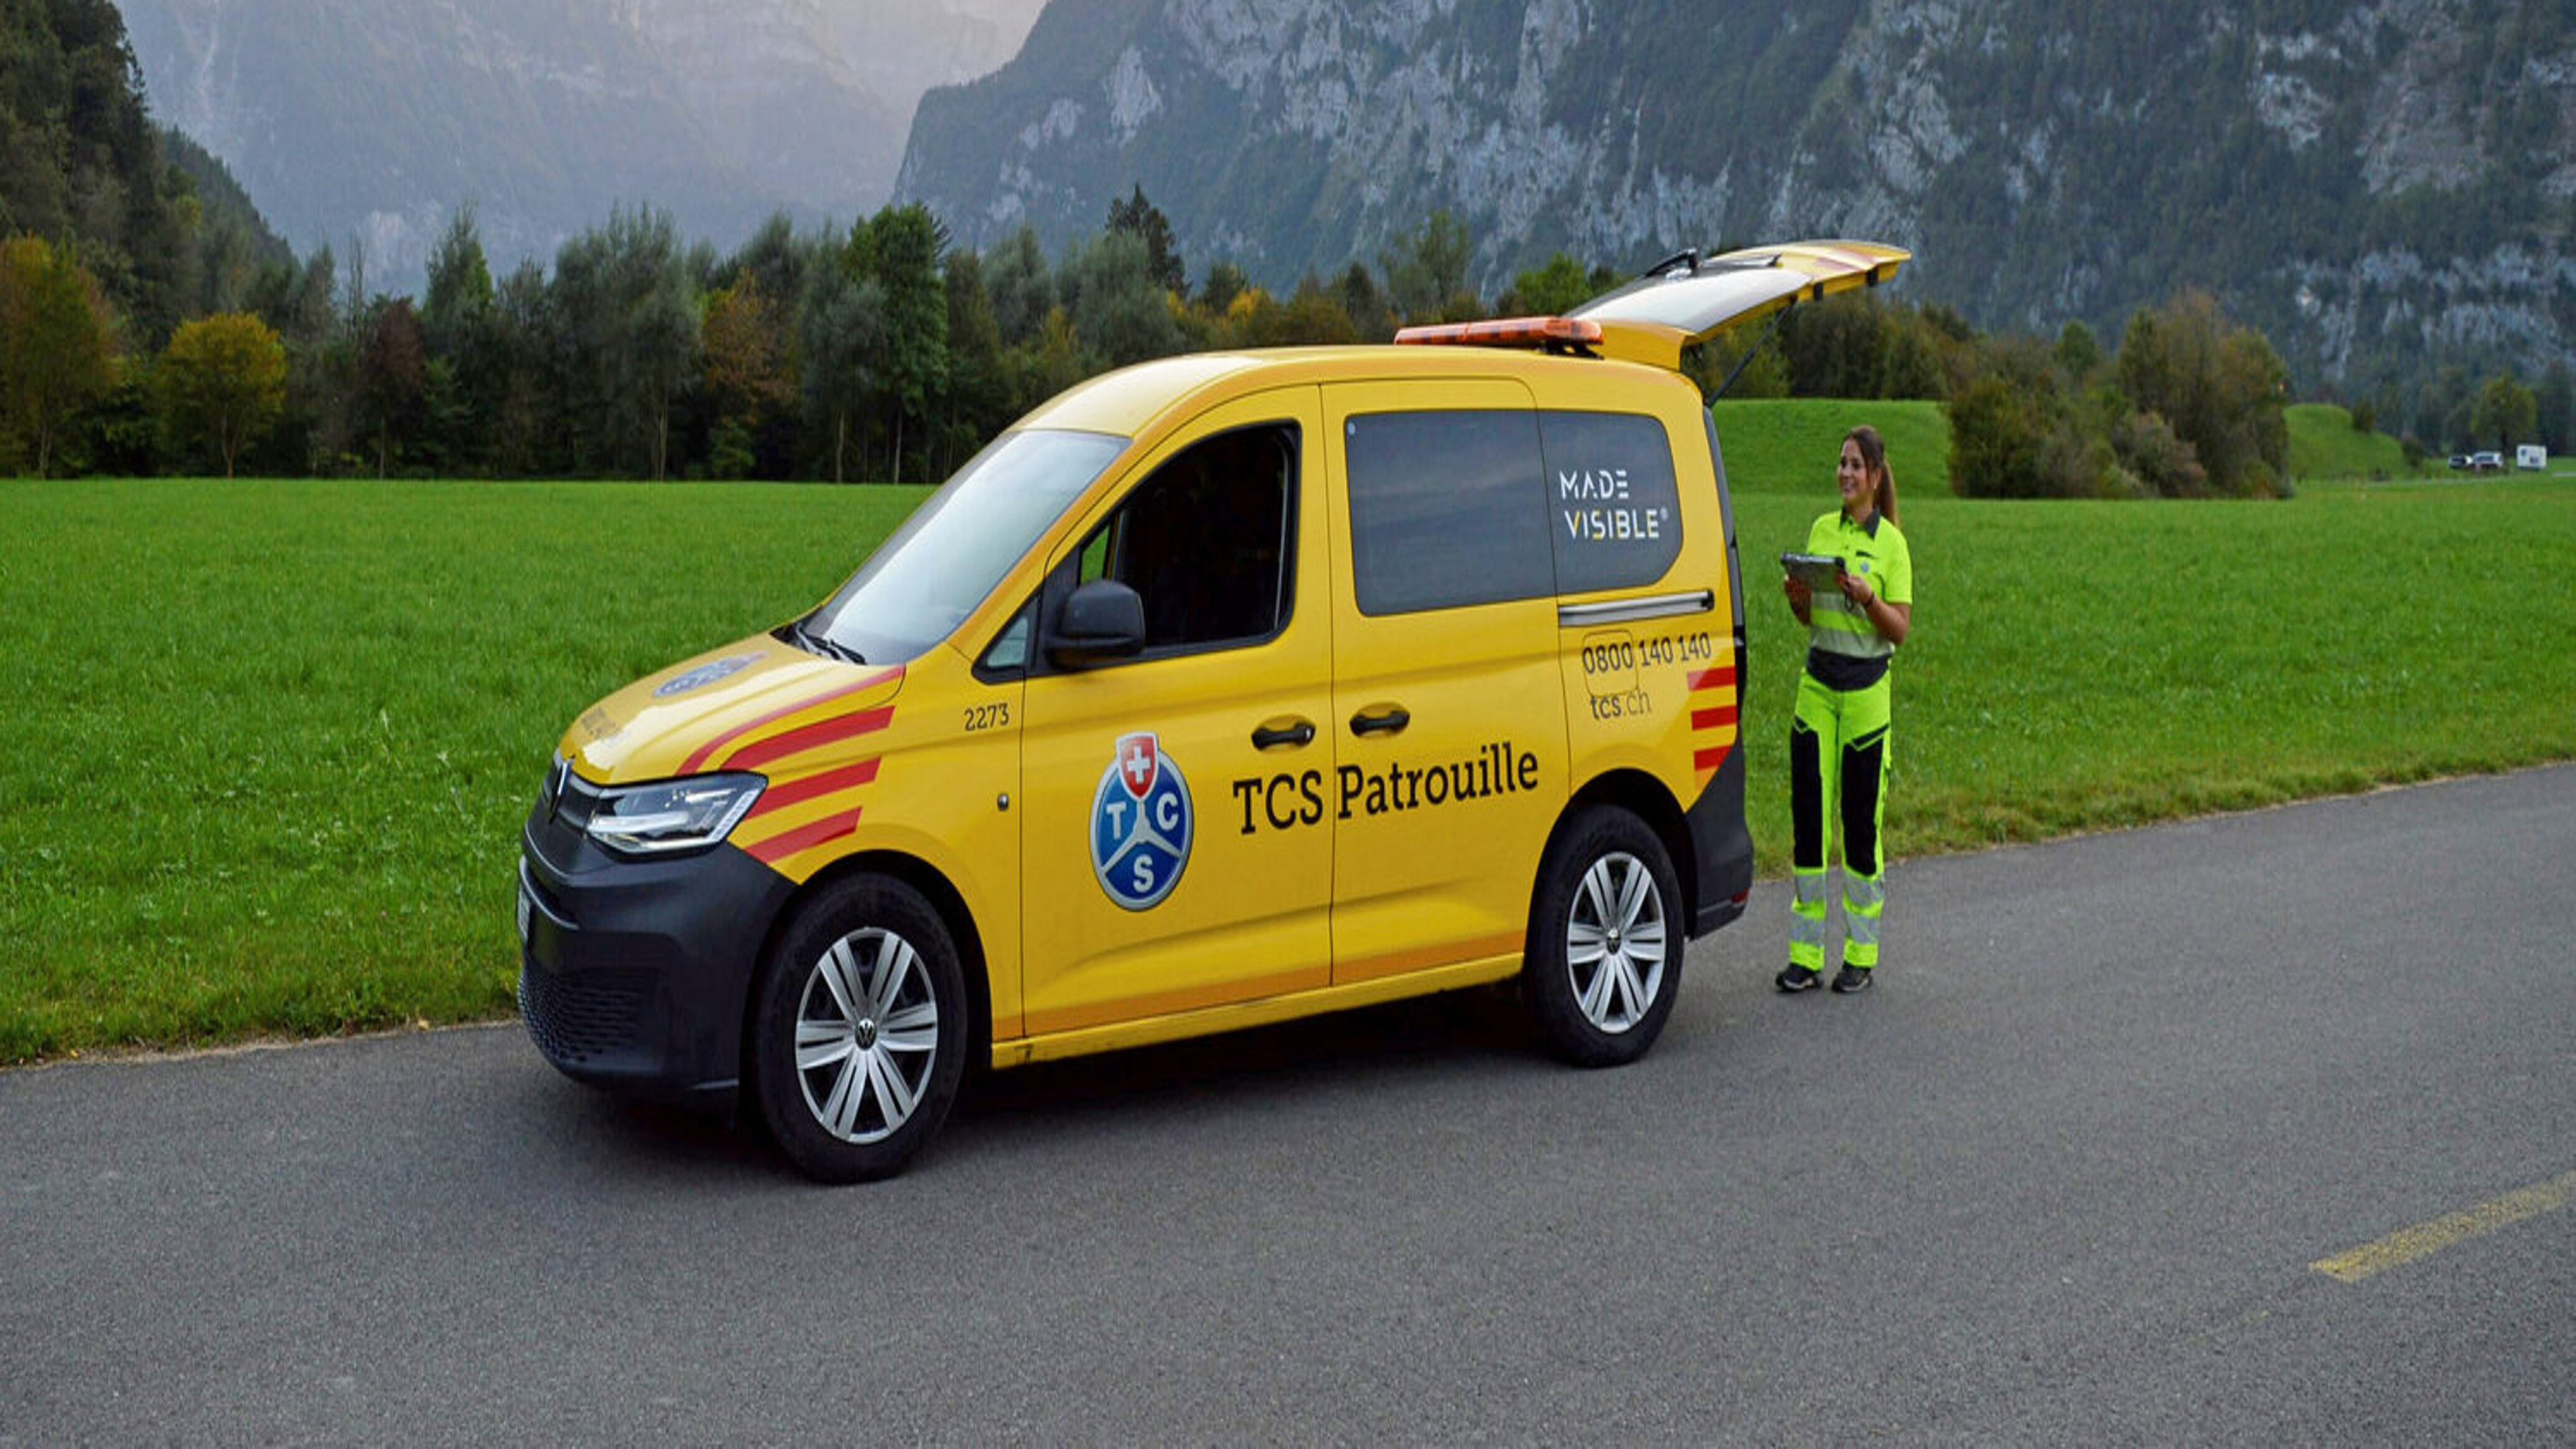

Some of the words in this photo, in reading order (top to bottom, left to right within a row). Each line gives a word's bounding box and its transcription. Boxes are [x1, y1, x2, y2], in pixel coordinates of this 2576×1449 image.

[1559, 470, 1629, 500] MADE
[1582, 642, 1634, 674] 0800
[1639, 637, 1673, 666] 140
[1678, 632, 1711, 661] 140
[964, 702, 1009, 732] 2273
[1591, 687, 1651, 719] tcs.ch
[1232, 770, 1324, 835] TCS
[1337, 742, 1539, 819] Patrouille
